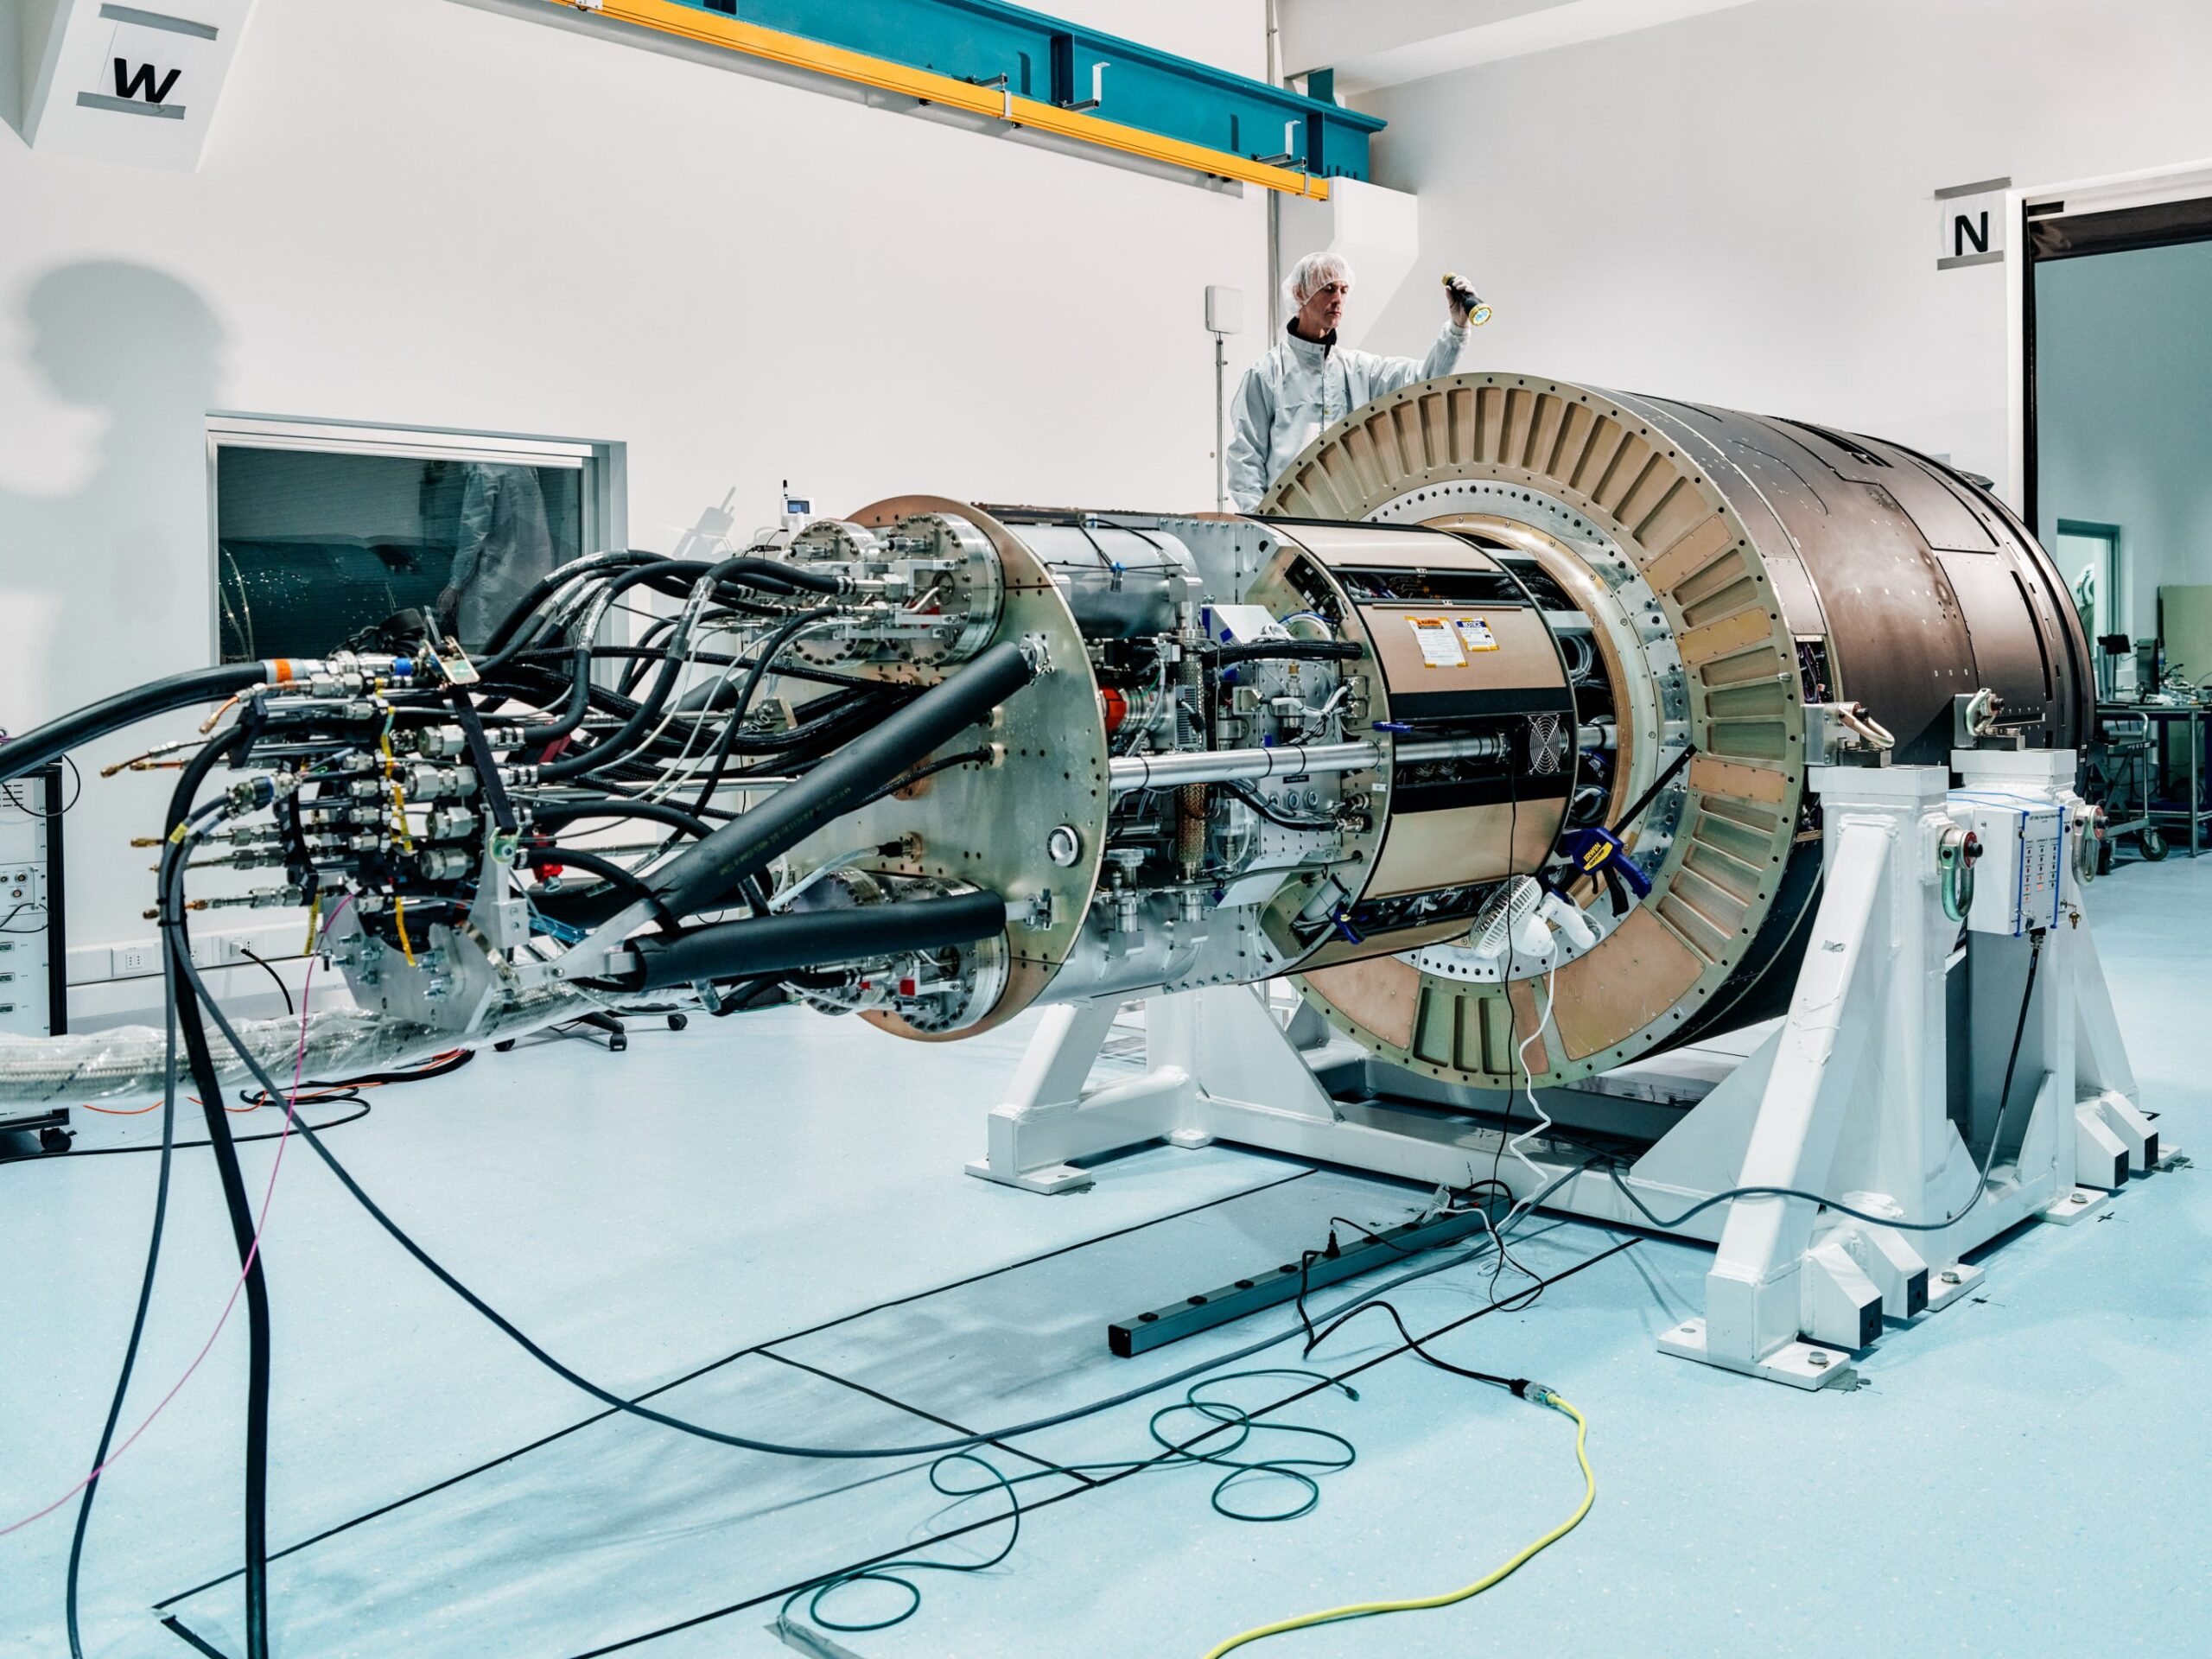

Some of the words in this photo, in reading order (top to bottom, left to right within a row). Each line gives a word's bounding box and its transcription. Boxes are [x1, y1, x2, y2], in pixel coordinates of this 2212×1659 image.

[113, 57, 182, 104] W
[1955, 211, 1988, 256] N
[1583, 842, 1601, 862] IRWIN
